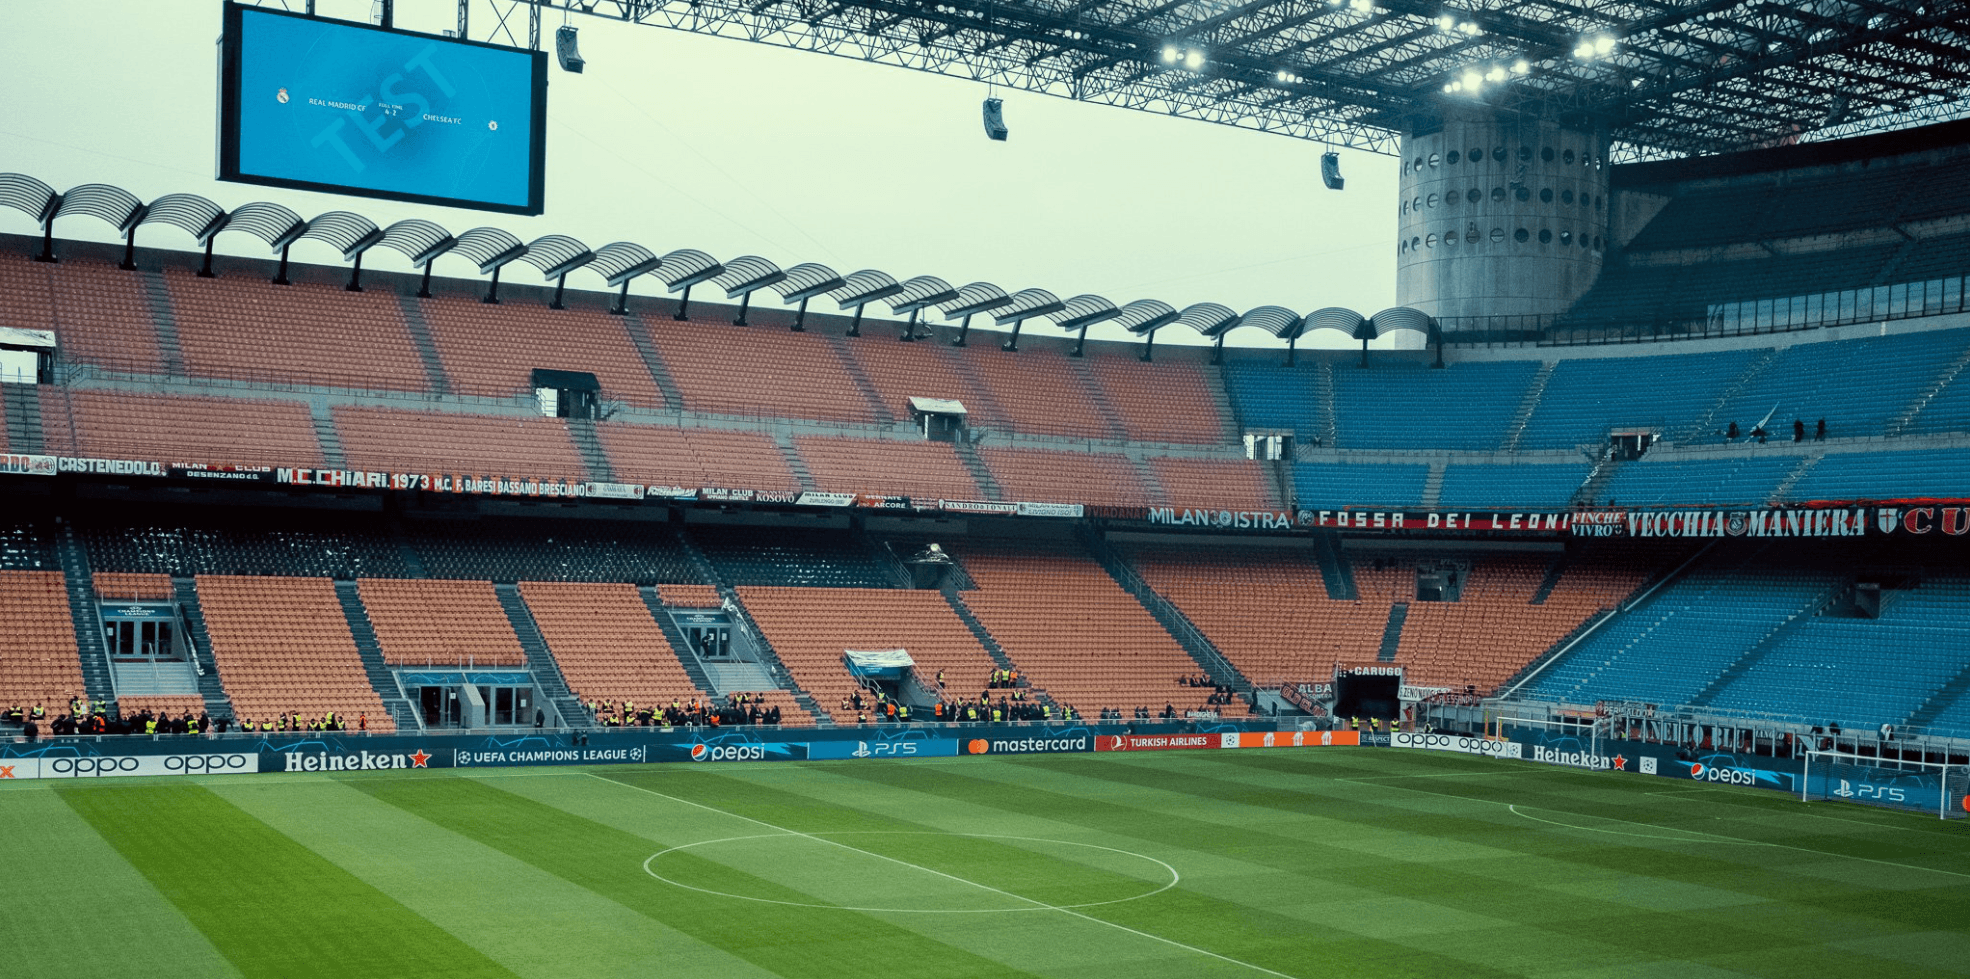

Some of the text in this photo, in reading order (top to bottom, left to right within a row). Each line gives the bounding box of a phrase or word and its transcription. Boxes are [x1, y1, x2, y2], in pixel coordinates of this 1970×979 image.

[308, 97, 367, 112] REAL MADRID CF
[310, 43, 457, 174] TEST
[422, 113, 462, 125] CHELSEA FC
[172, 462, 208, 470] MILAN
[186, 470, 246, 480] DESENZANO
[391, 473, 430, 490] 1973
[465, 479, 496, 493] BARESI
[497, 481, 538, 495] BASSANO
[538, 482, 586, 497] BRESCIANO
[702, 487, 728, 495] MILAN
[731, 489, 754, 497] CLUB
[755, 493, 795, 503] KOSOVO
[1150, 507, 1290, 529] MILAN ISTRA
[1319, 511, 1569, 530] FOSSA DEI LEONI
[1627, 508, 1866, 538] VECCHIA MANIERA
[1354, 666, 1401, 676] CARUGO
[1298, 683, 1333, 693] ALBA
[875, 742, 917, 755] PS5
[993, 736, 1086, 752] mastercard
[1130, 735, 1208, 748] TURKISH AIRLINES
[1397, 732, 1503, 755] oppo oppo
[474, 748, 628, 763] UEFA CHAMPIONS LEAGUE
[711, 743, 765, 761] pepsi
[1533, 745, 1611, 769] Heineken
[52, 753, 246, 777] oppo oppo
[284, 751, 408, 772] Heineken
[1708, 766, 1756, 786] pepsi
[1858, 783, 1905, 802] PS5
